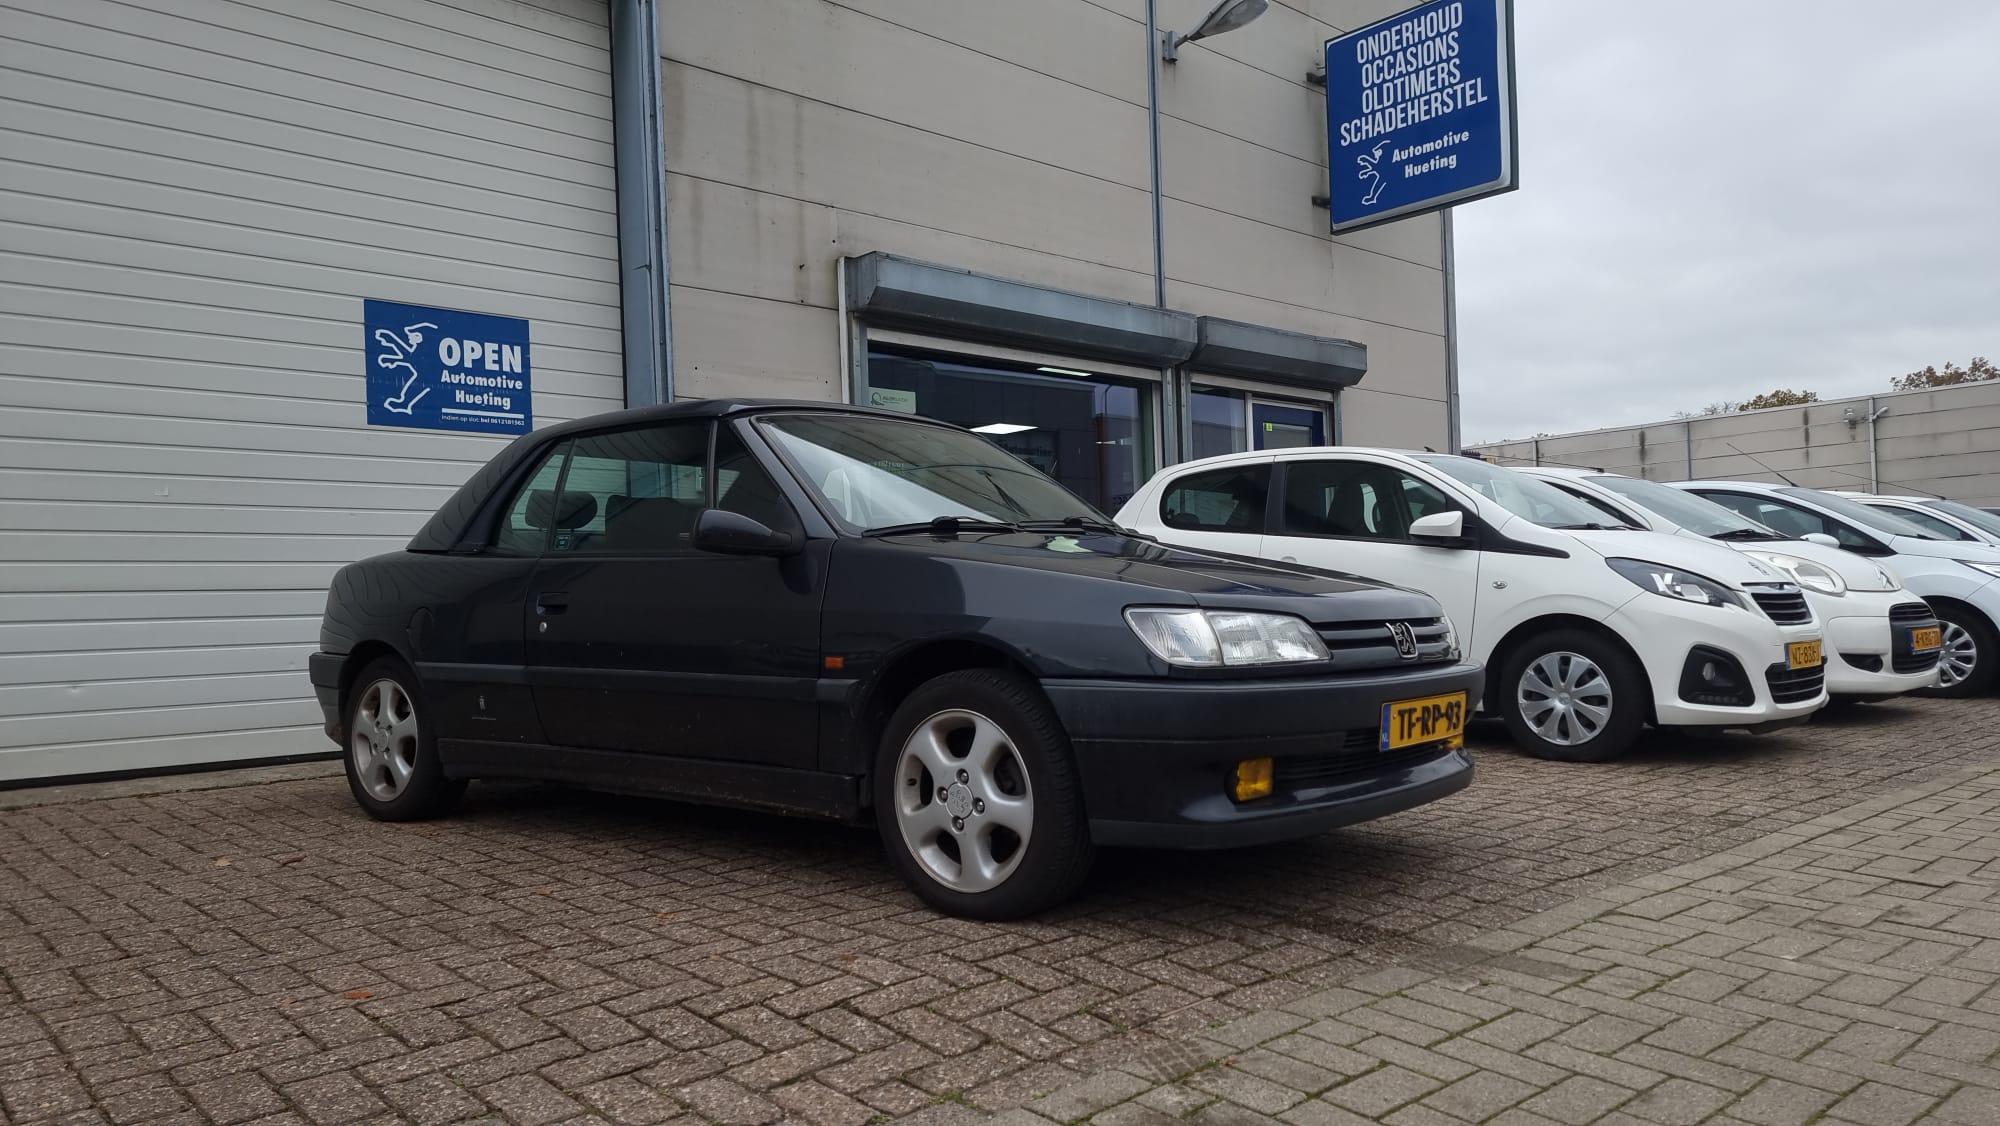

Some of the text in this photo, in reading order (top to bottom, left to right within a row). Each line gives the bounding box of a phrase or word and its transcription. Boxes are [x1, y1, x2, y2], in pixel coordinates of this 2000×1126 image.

[1356, 2, 1463, 64] ONDERHOUD
[1361, 31, 1459, 88] OCCASIONS
[1361, 58, 1461, 114] OLDTIMERS
[1340, 77, 1488, 147] SCHADEHERSTEL
[1391, 130, 1470, 163] Automotive
[1404, 154, 1457, 178] Hueting
[438, 337, 522, 373] OPEN
[440, 370, 523, 390] Automotive
[455, 390, 511, 410] Hueting
[1397, 700, 1462, 741] TF-RP-93
